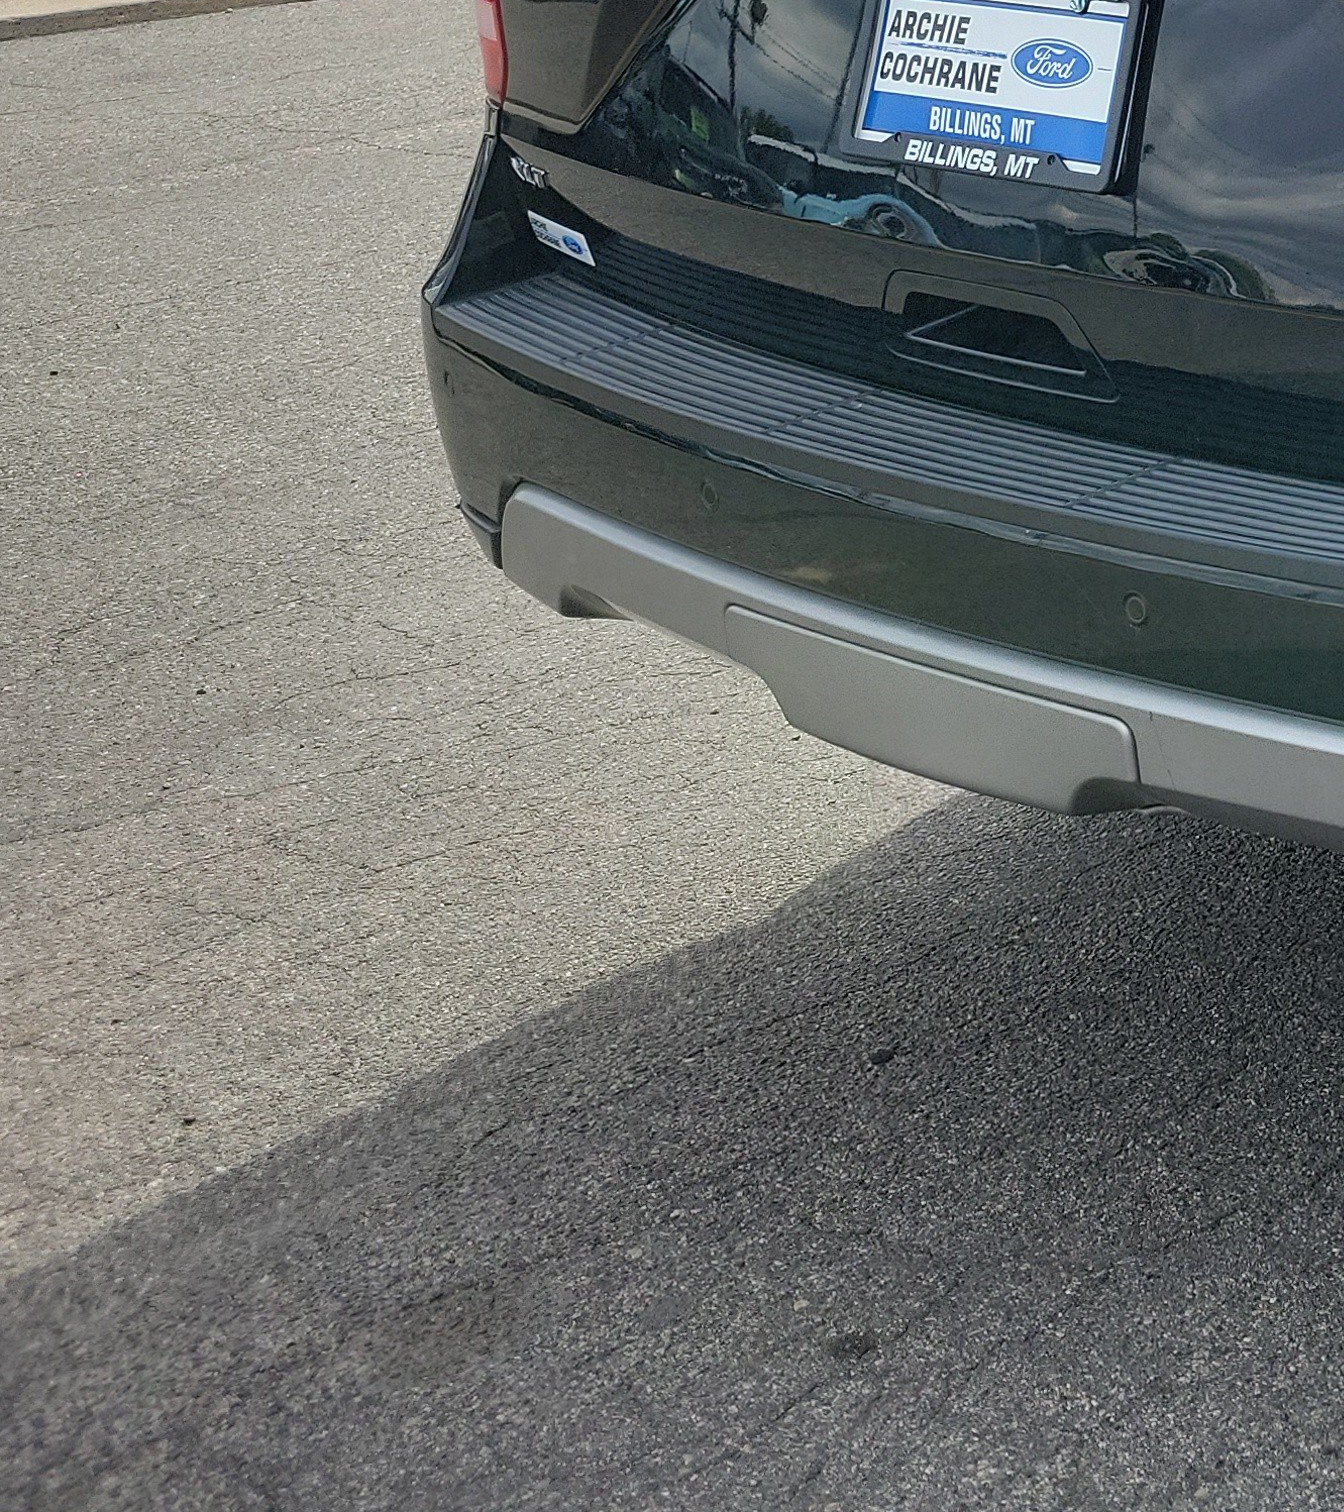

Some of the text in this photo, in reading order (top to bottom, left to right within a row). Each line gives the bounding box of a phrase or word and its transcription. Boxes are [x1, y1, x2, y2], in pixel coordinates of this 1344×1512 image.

[888, 9, 972, 45] ARCHIE
[879, 51, 1002, 94] COCHRANE
[1025, 44, 1076, 80] Ford
[929, 106, 1036, 145] BILLINGS, MT
[904, 139, 1039, 179] BILLINGS, MT
